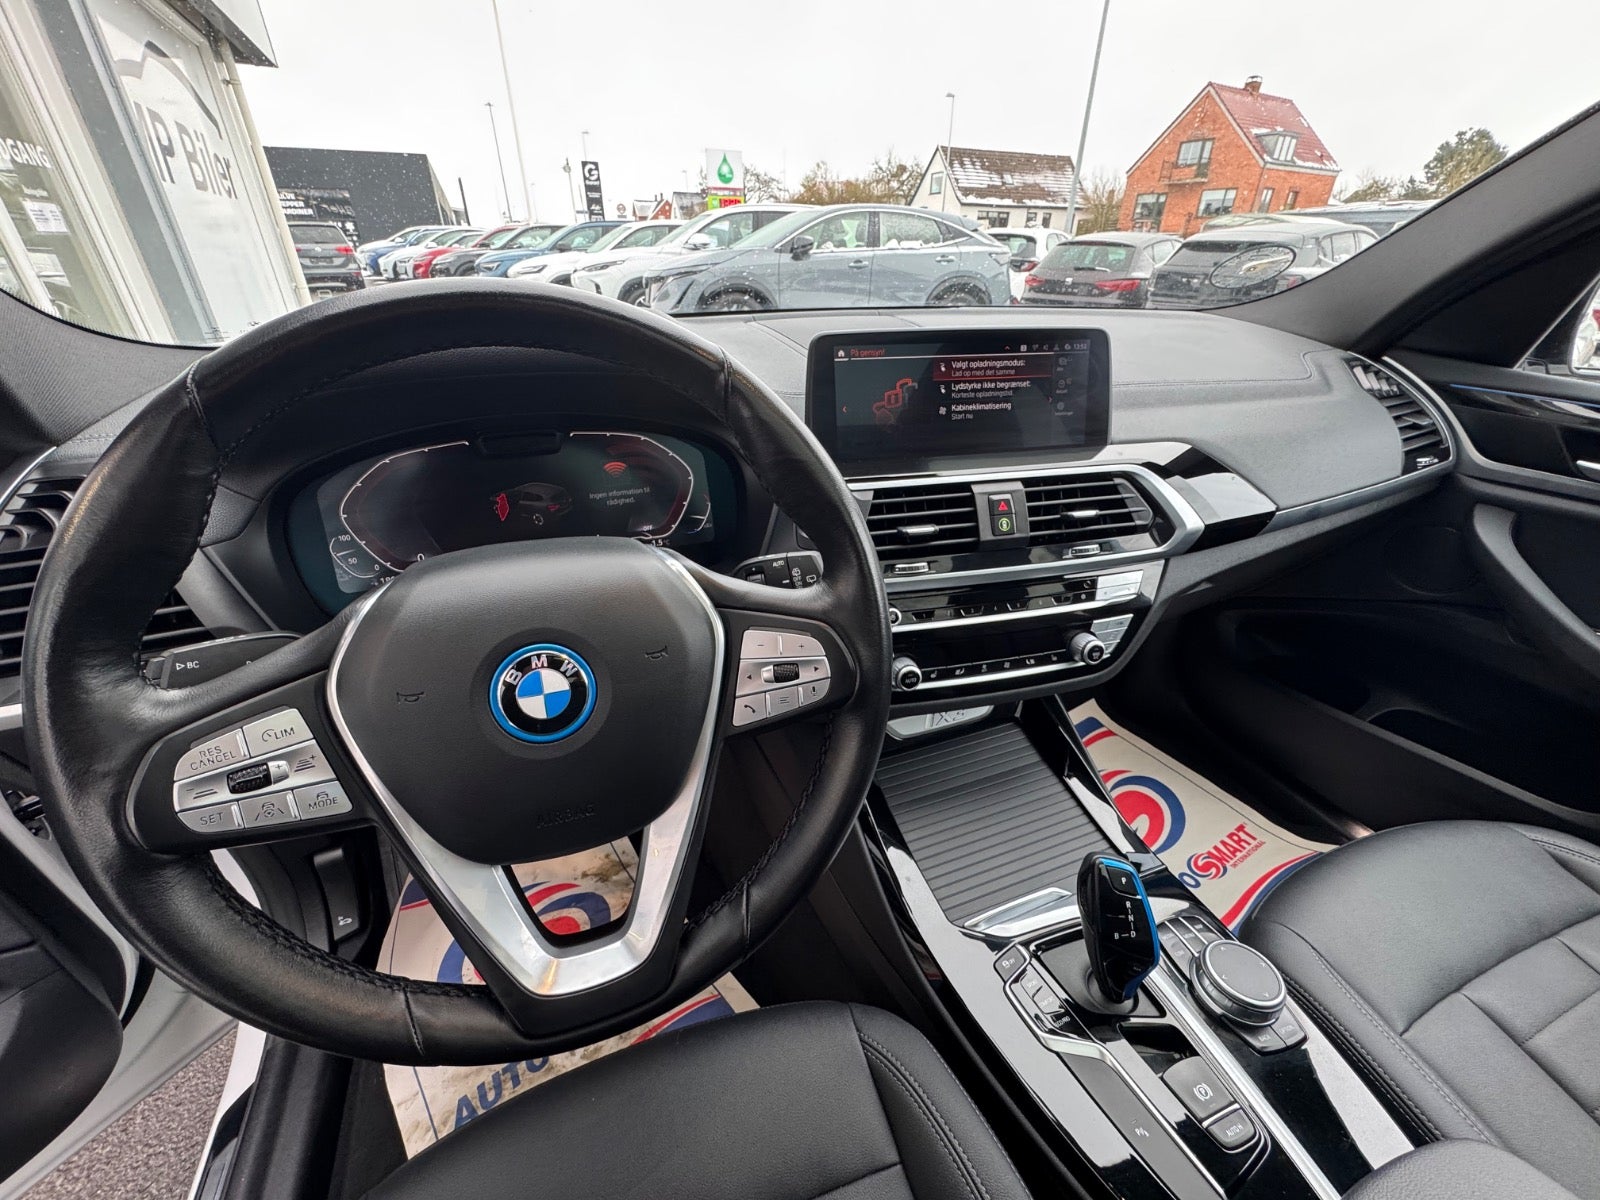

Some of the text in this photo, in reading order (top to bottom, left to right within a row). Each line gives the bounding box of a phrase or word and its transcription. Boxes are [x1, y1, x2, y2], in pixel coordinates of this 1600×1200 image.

[174, 120, 238, 200] Biler
[951, 358, 1026, 370] Valgt opladningsmodus:
[951, 369, 963, 377] Lad
[963, 370, 971, 378] op
[971, 368, 985, 376] med
[951, 382, 982, 392] Lydstyrke
[982, 381, 996, 389] ikke
[951, 402, 1012, 412] Kabineklimatisering
[951, 412, 965, 420] Start
[589, 492, 608, 500] Ingen
[608, 488, 643, 498] information
[373, 563, 380, 571] 0
[186, 660, 200, 670] BC
[504, 653, 579, 687] BMW
[274, 726, 296, 741] LIM
[199, 745, 222, 758] RES
[189, 750, 237, 771] CANCEL
[308, 796, 338, 811] MODE
[200, 812, 225, 826] SET
[1121, 877, 1127, 885] P
